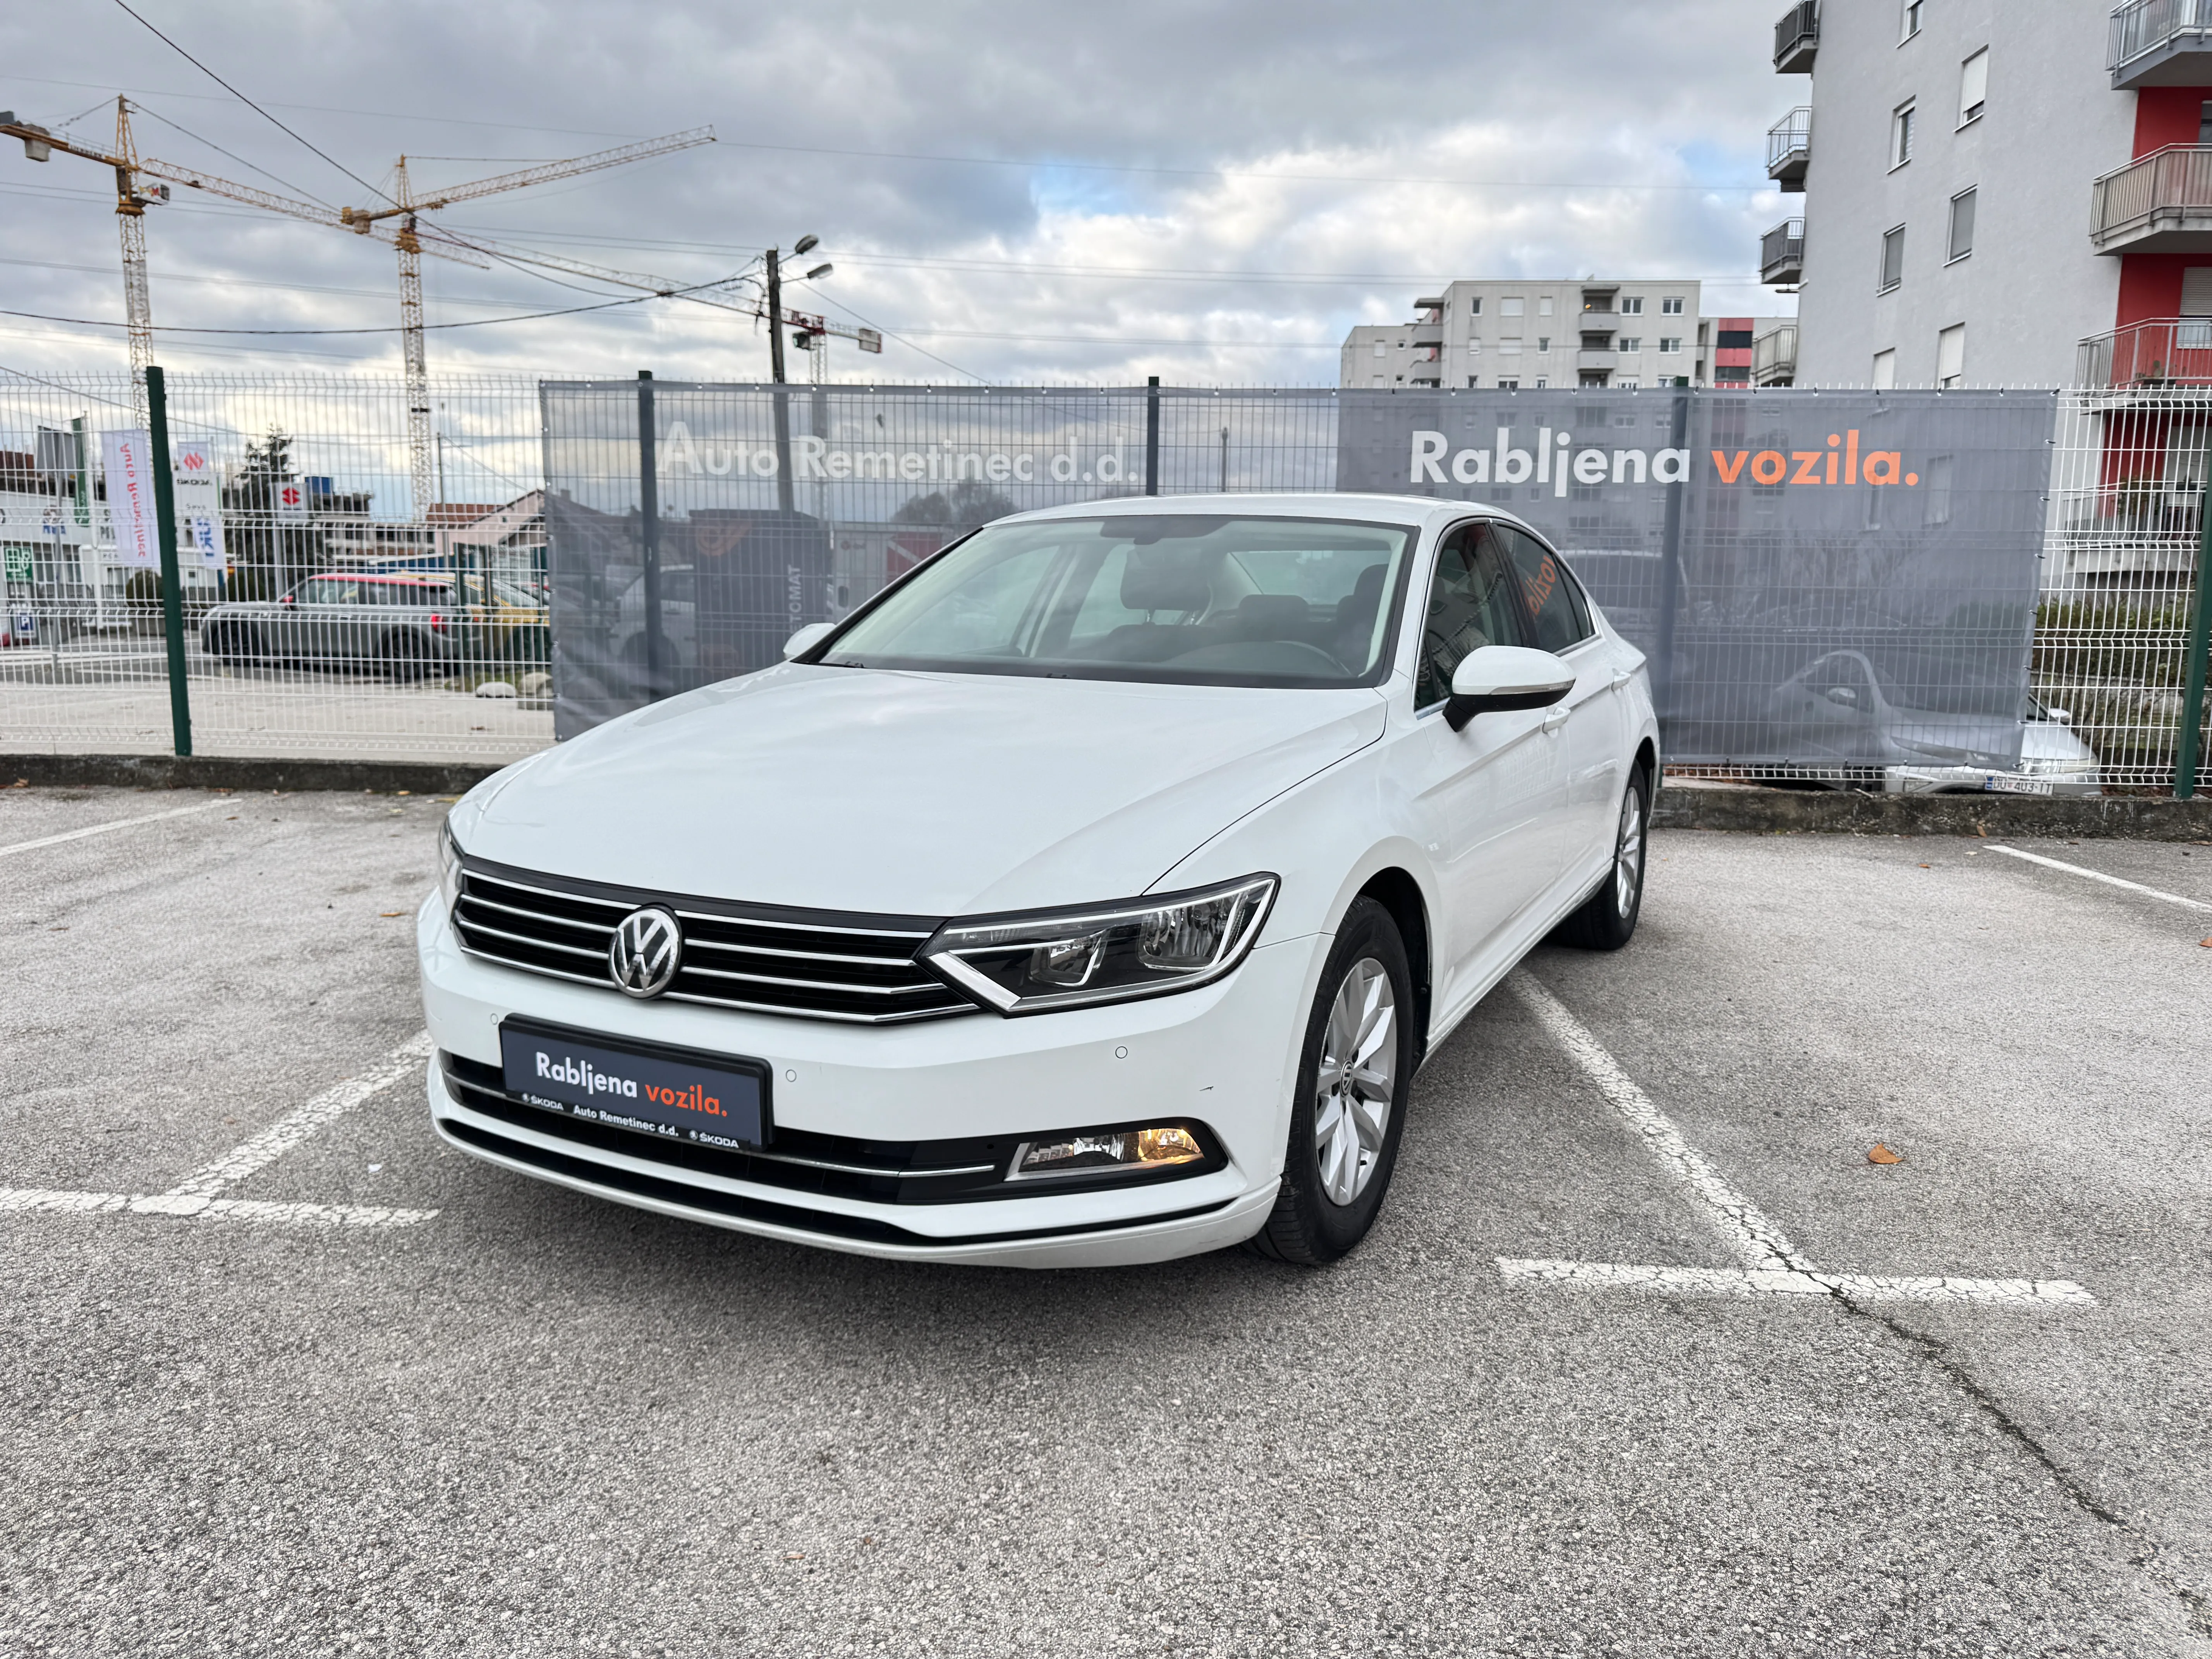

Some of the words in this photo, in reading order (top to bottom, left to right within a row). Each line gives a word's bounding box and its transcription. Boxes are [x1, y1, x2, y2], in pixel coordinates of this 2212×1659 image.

[656, 421, 779, 477] Auto
[798, 435, 1033, 482] Remetinec
[1050, 436, 1138, 482] d.d.
[1410, 428, 1690, 497] Rabljena
[1711, 429, 1919, 486] vozila.
[531, 1094, 564, 1111] ŠKODA
[536, 1051, 637, 1097] Rabljena
[645, 1084, 727, 1117] vozila.
[573, 1104, 598, 1118] Auto
[599, 1110, 656, 1131] Remetinec
[658, 1124, 679, 1137] d.d.
[700, 1132, 739, 1148] ŠKODA
